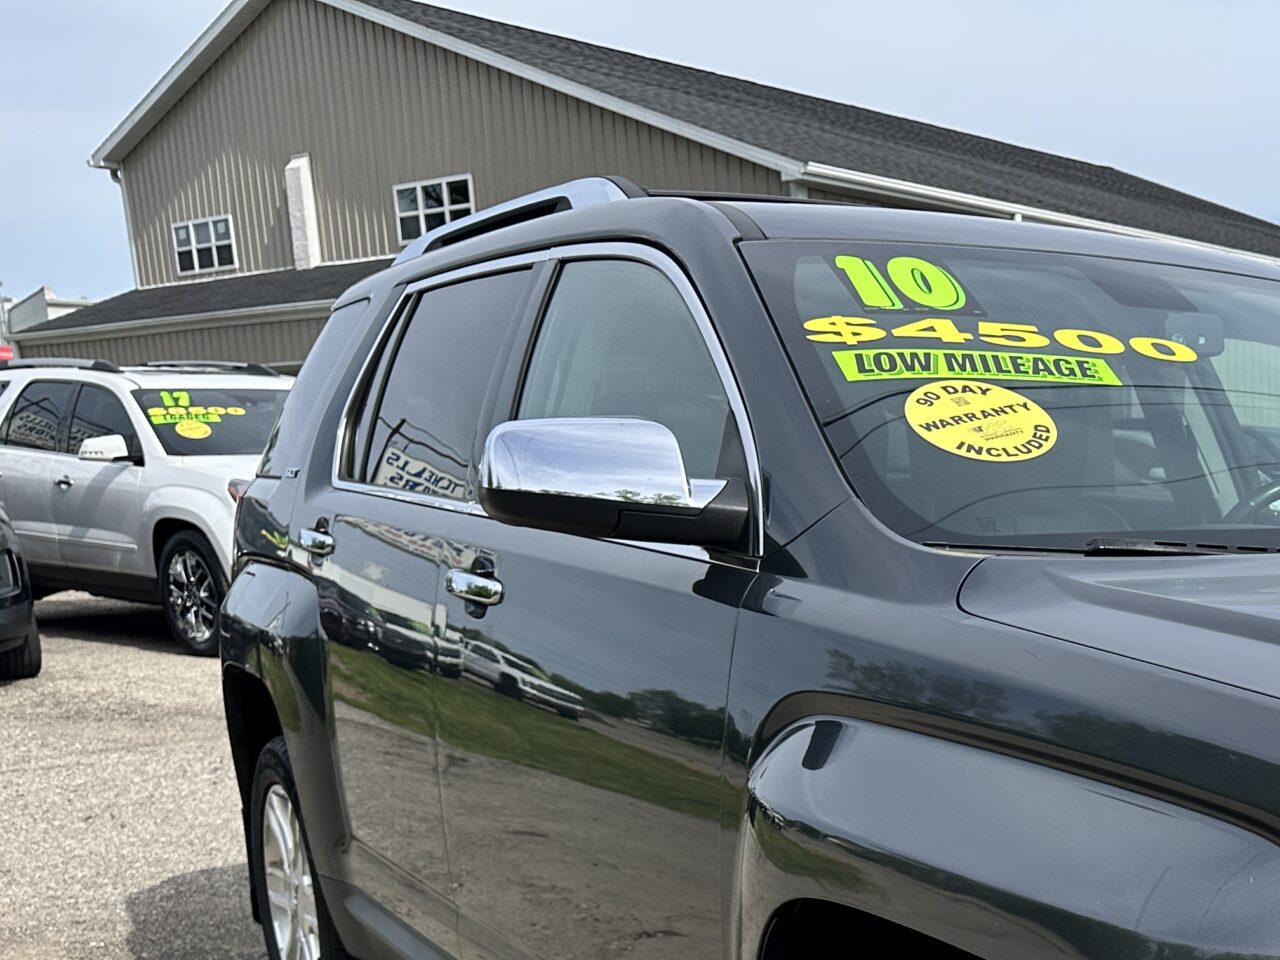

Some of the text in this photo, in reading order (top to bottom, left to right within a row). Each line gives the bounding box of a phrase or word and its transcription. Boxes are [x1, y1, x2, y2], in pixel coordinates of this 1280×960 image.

[835, 255, 966, 310] 10
[802, 315, 1199, 363] $4500
[854, 351, 1102, 381] LOW MILEAGE
[160, 391, 190, 407] 17
[915, 385, 993, 407] 90 DAY
[918, 402, 1032, 432] WARRANTY
[955, 424, 1051, 457] INCLUDED
